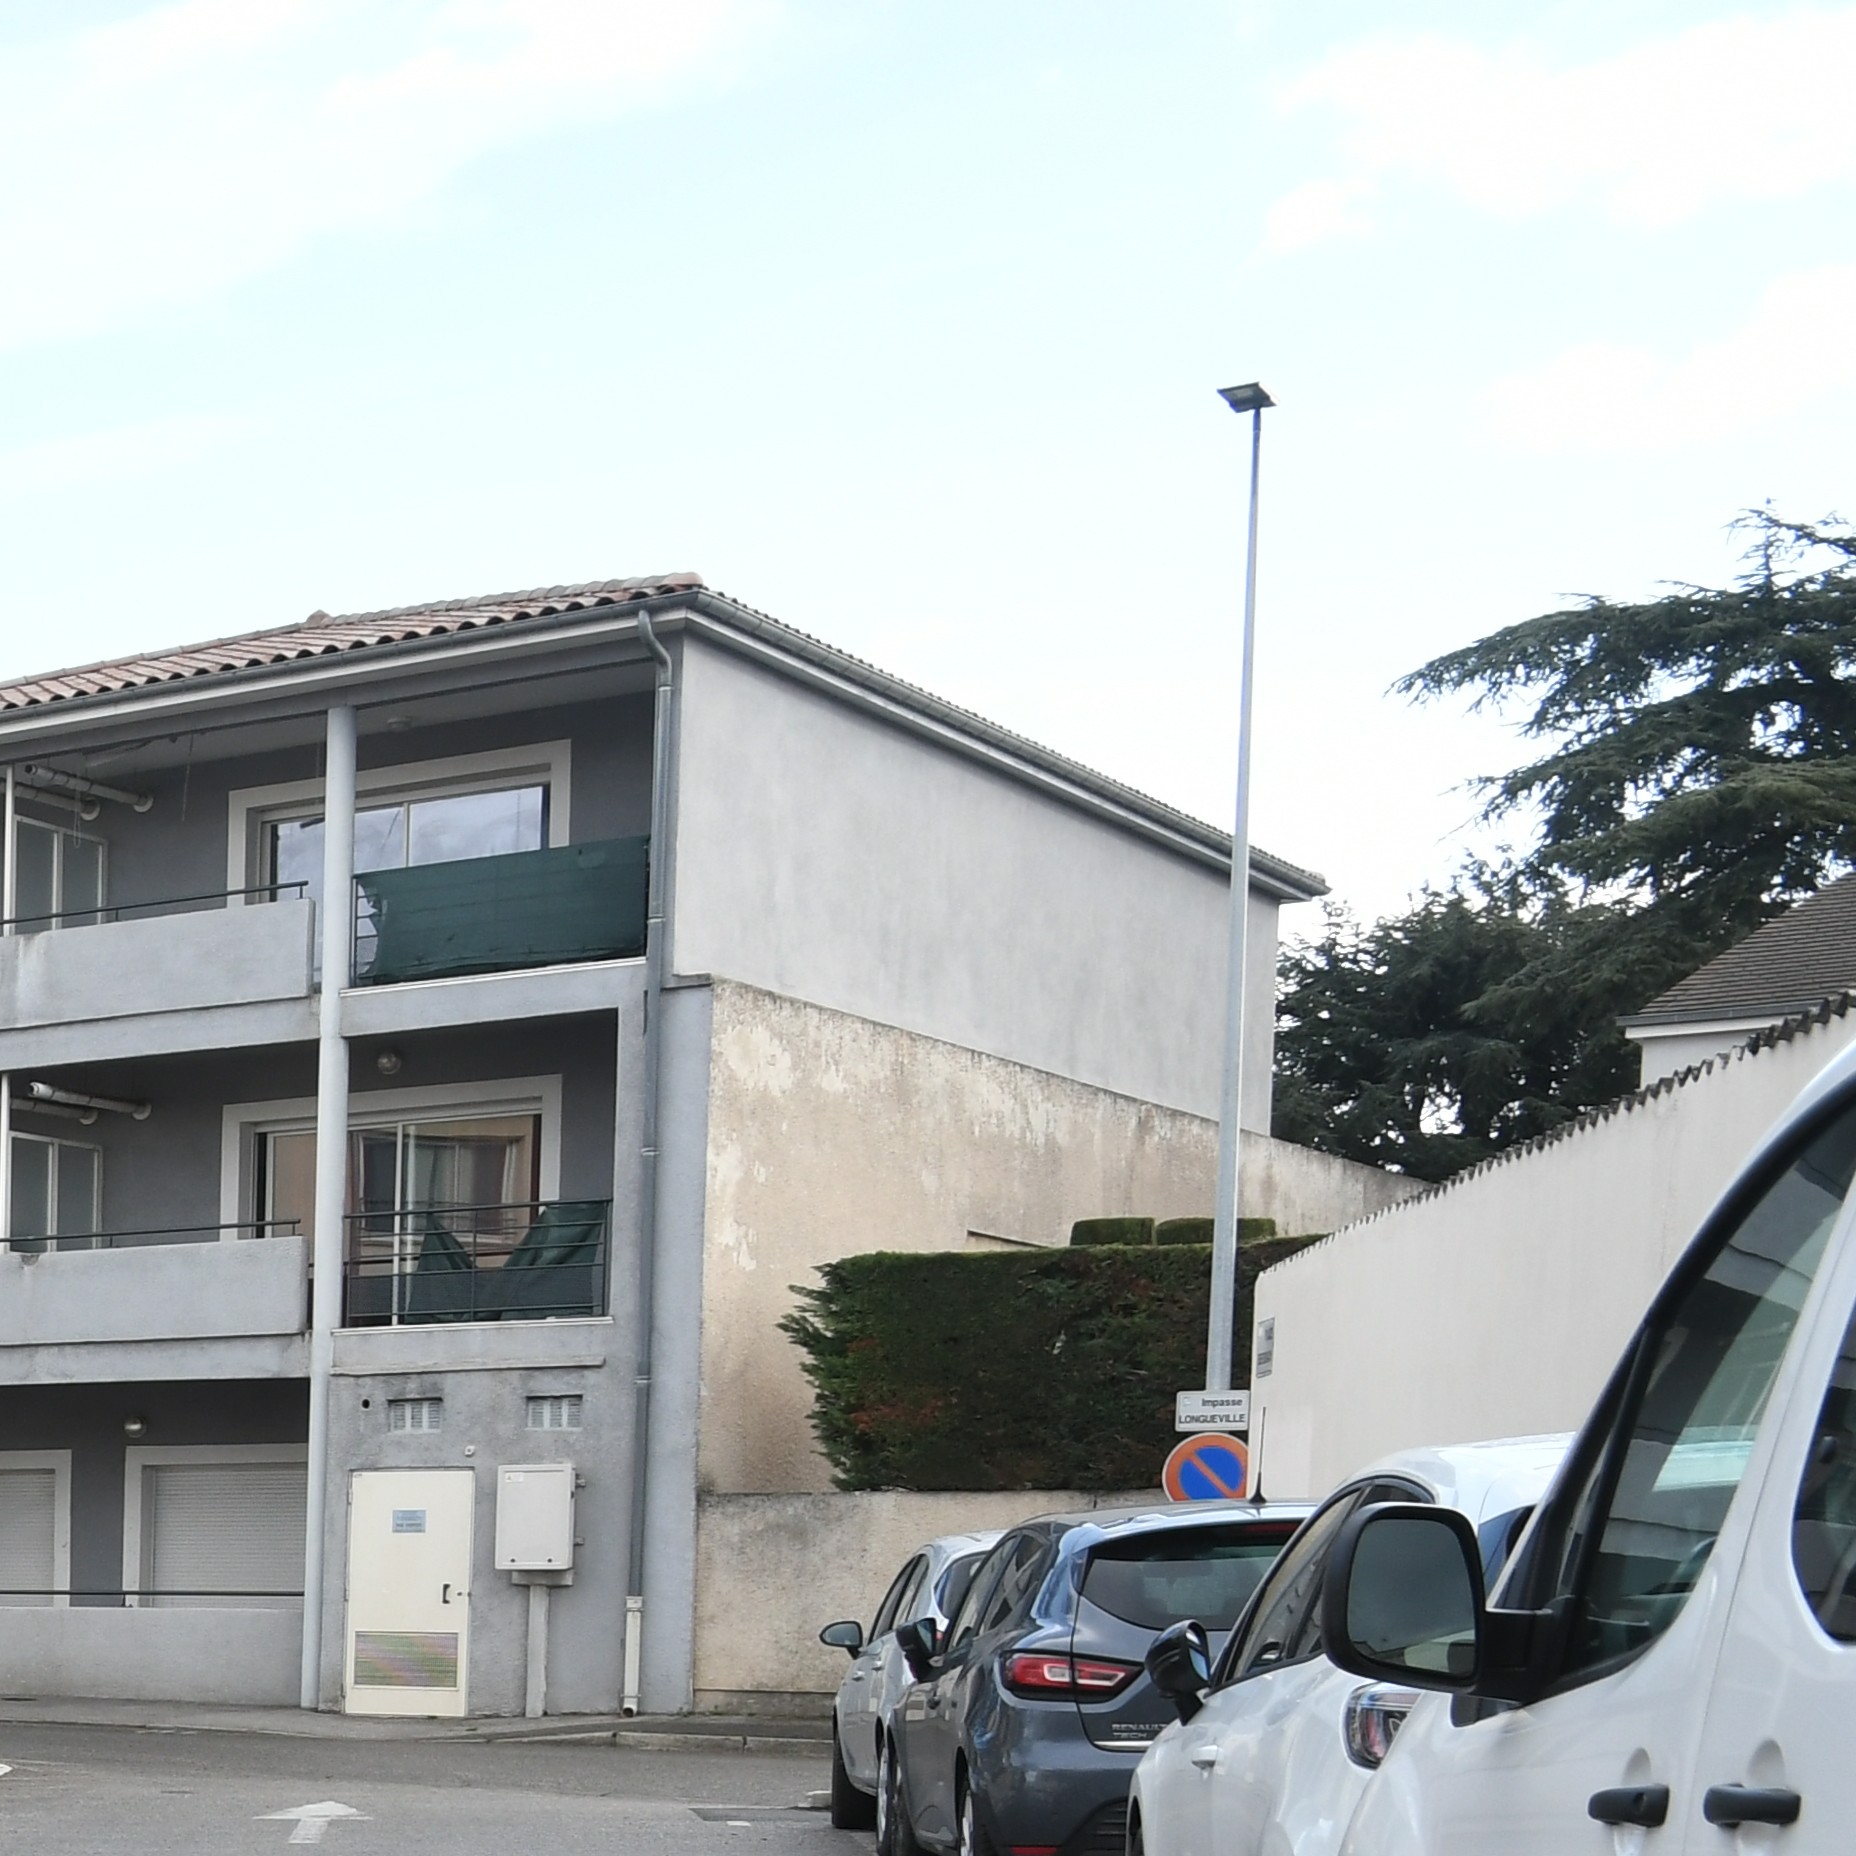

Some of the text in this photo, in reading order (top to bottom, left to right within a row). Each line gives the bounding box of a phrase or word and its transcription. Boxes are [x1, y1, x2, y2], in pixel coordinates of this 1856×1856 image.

[1201, 1398, 1243, 1408] Impasse
[1178, 1413, 1246, 1424] LONGUEVILLE
[1111, 1723, 1169, 1731] RENAULT
